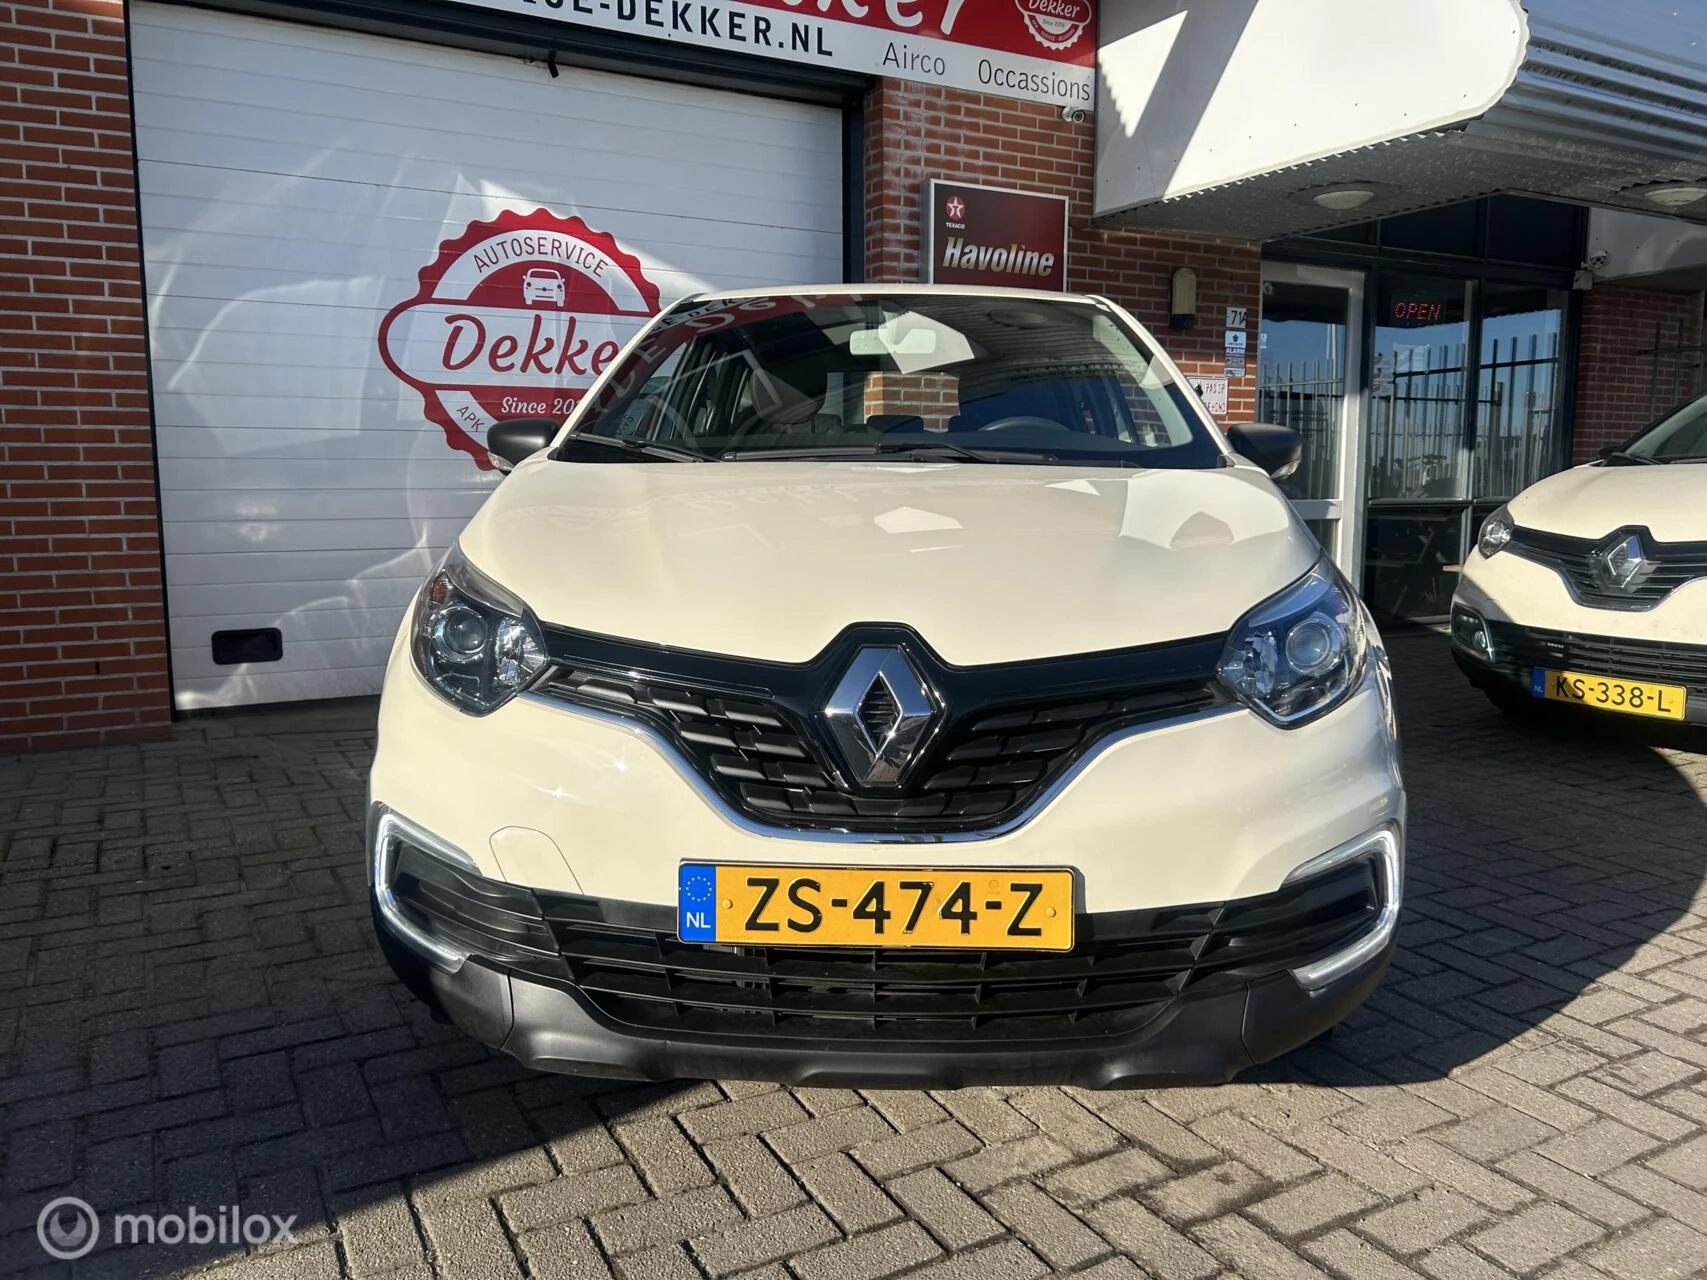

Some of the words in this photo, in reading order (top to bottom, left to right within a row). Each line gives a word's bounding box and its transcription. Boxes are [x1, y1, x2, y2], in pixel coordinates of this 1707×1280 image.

[524, 0, 833, 56] -DEKKER.NL
[882, 42, 946, 76] Airco
[978, 59, 1091, 101] Occassions
[945, 221, 966, 230] TEXACO
[472, 236, 609, 278] AUTOSERVICE
[942, 236, 1055, 277] Havoline
[1395, 302, 1441, 320] OPEN
[456, 405, 486, 433] APK
[500, 396, 546, 415] Since
[552, 398, 580, 416] 20
[1556, 675, 1671, 712] KS-338-L
[686, 911, 711, 929] NL
[744, 877, 1043, 937] ZS-474-Z
